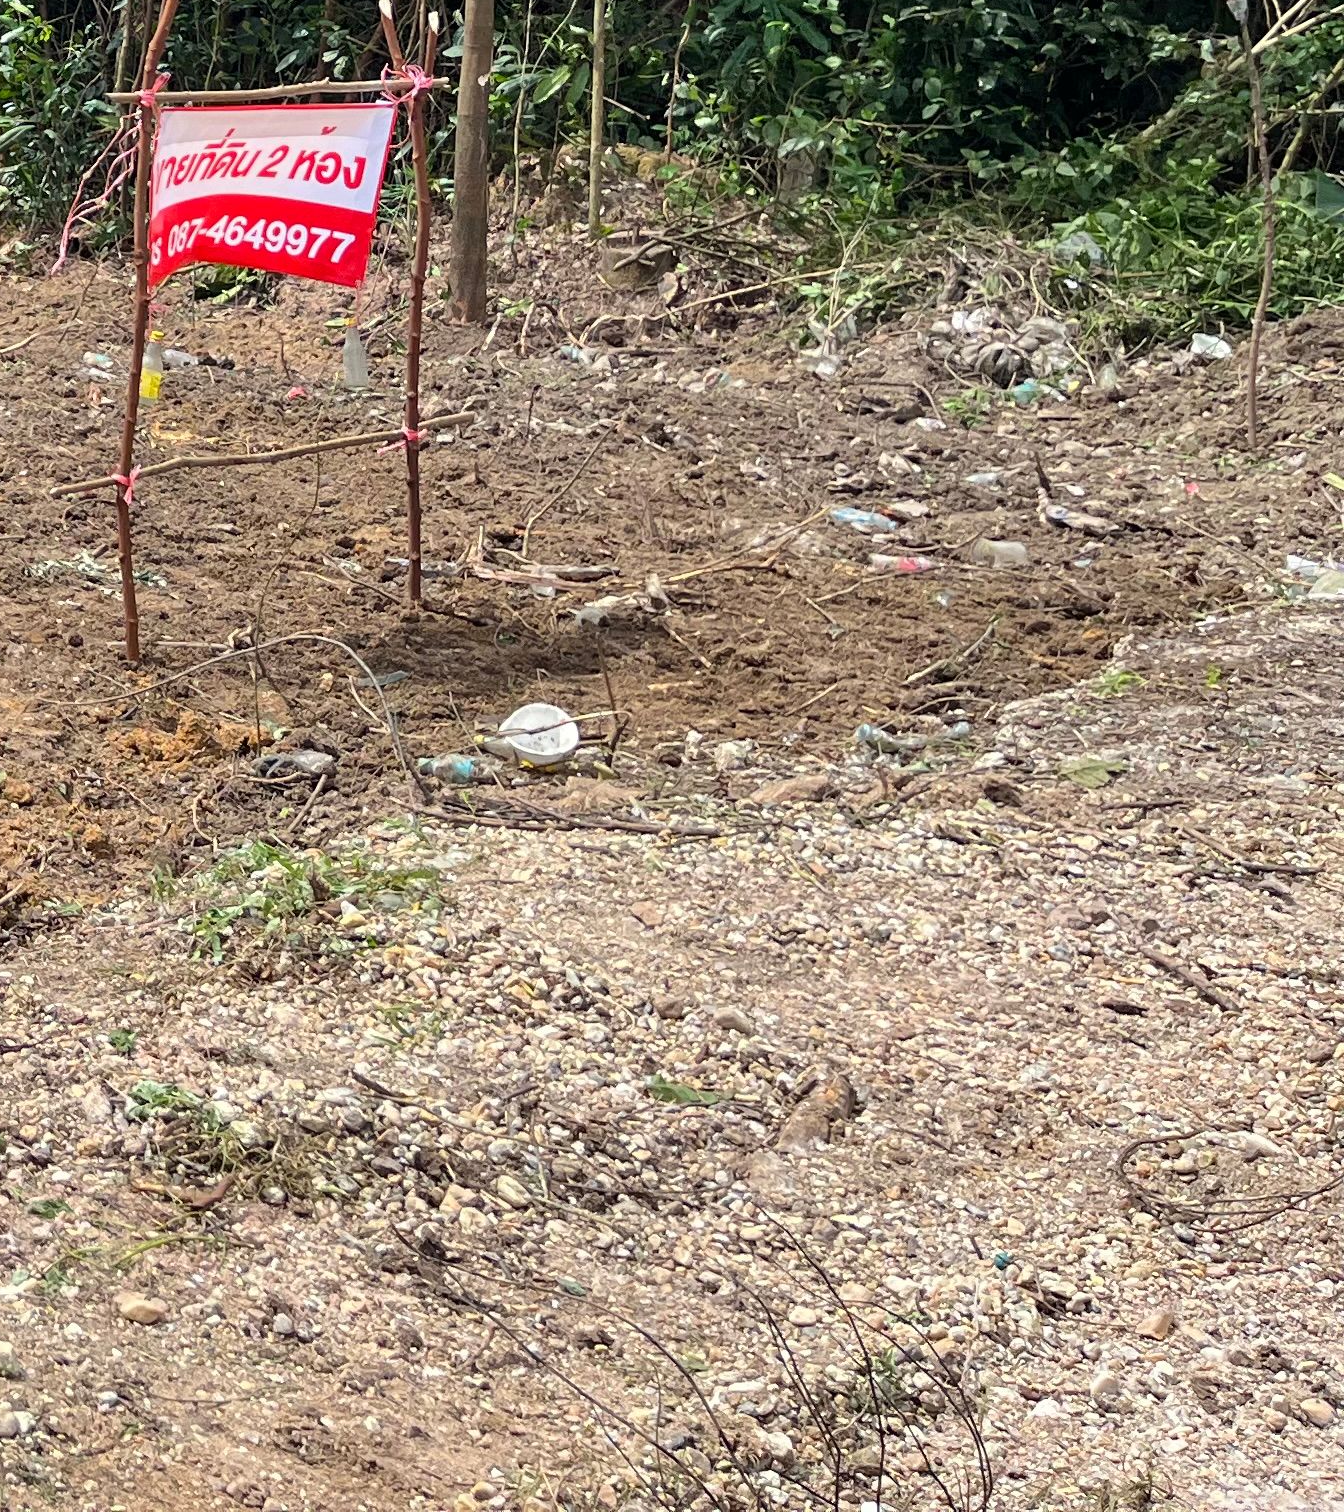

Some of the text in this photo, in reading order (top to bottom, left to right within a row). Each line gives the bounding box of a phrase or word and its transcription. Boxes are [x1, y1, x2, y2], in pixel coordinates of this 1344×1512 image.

[256, 145, 290, 178] 2
[288, 126, 367, 190] ห้อง
[167, 215, 356, 264] 087-4649977
